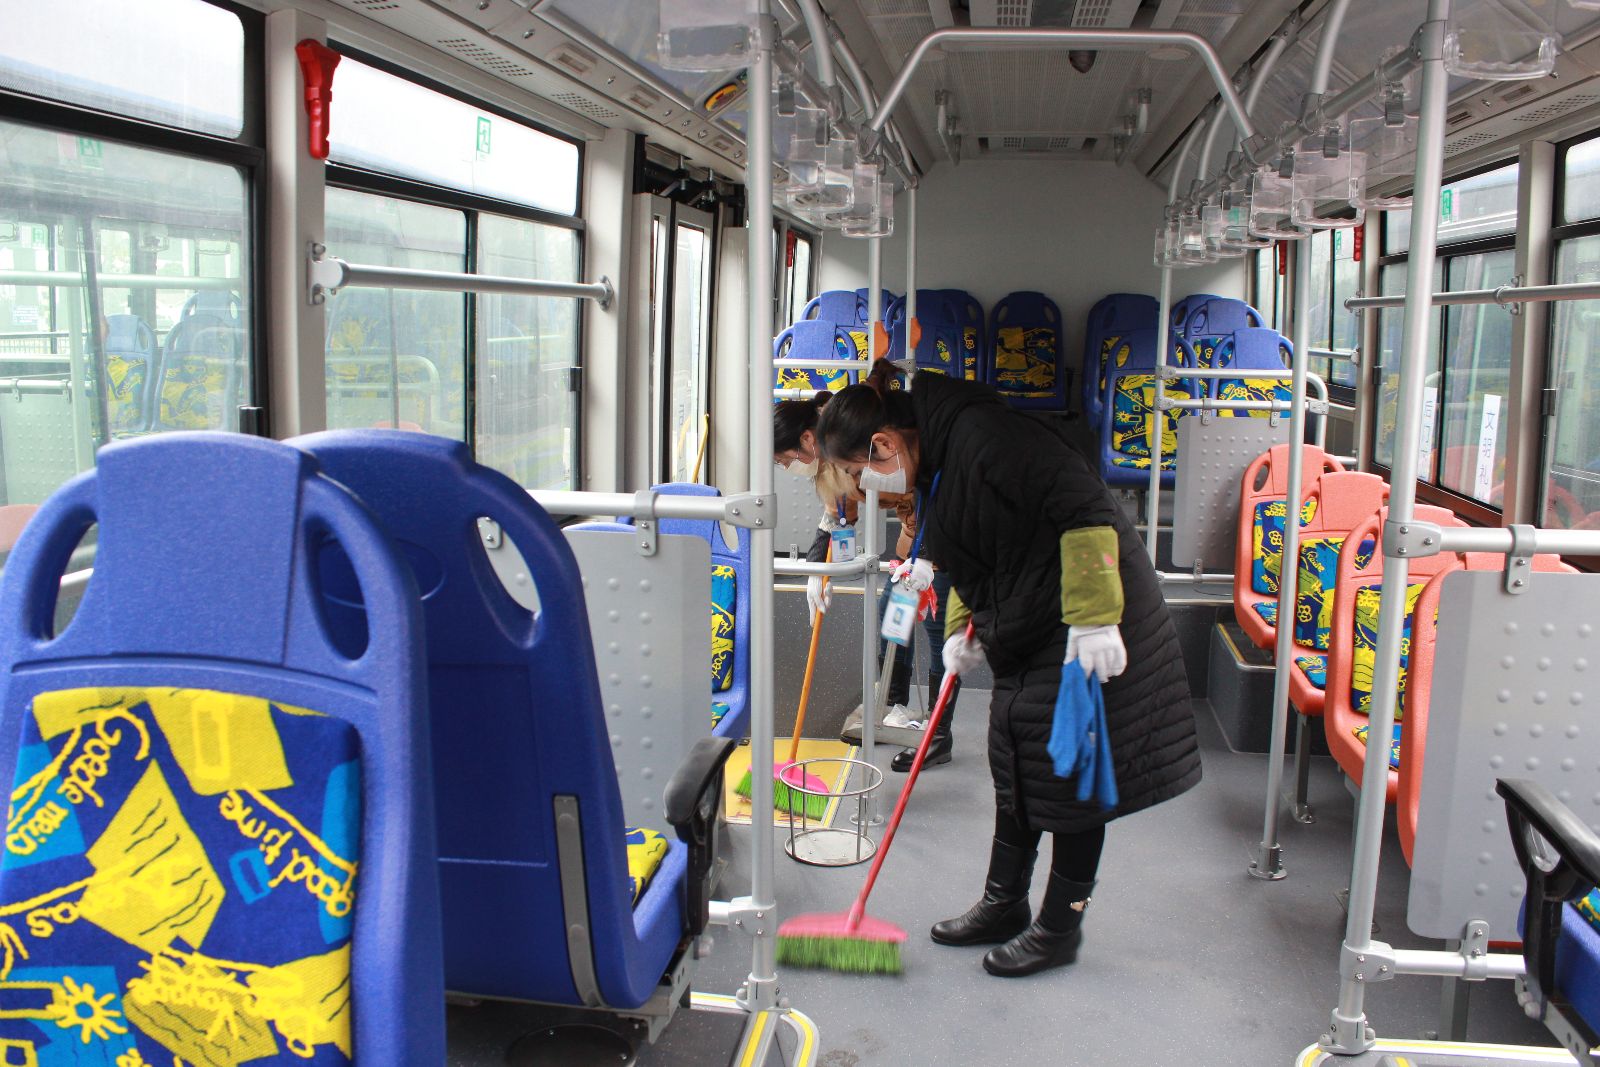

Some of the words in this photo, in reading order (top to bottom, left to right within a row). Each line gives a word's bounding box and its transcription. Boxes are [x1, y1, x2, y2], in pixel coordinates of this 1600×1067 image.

[57, 706, 151, 807] Goede
[217, 789, 294, 866] time
[267, 848, 357, 918] good
